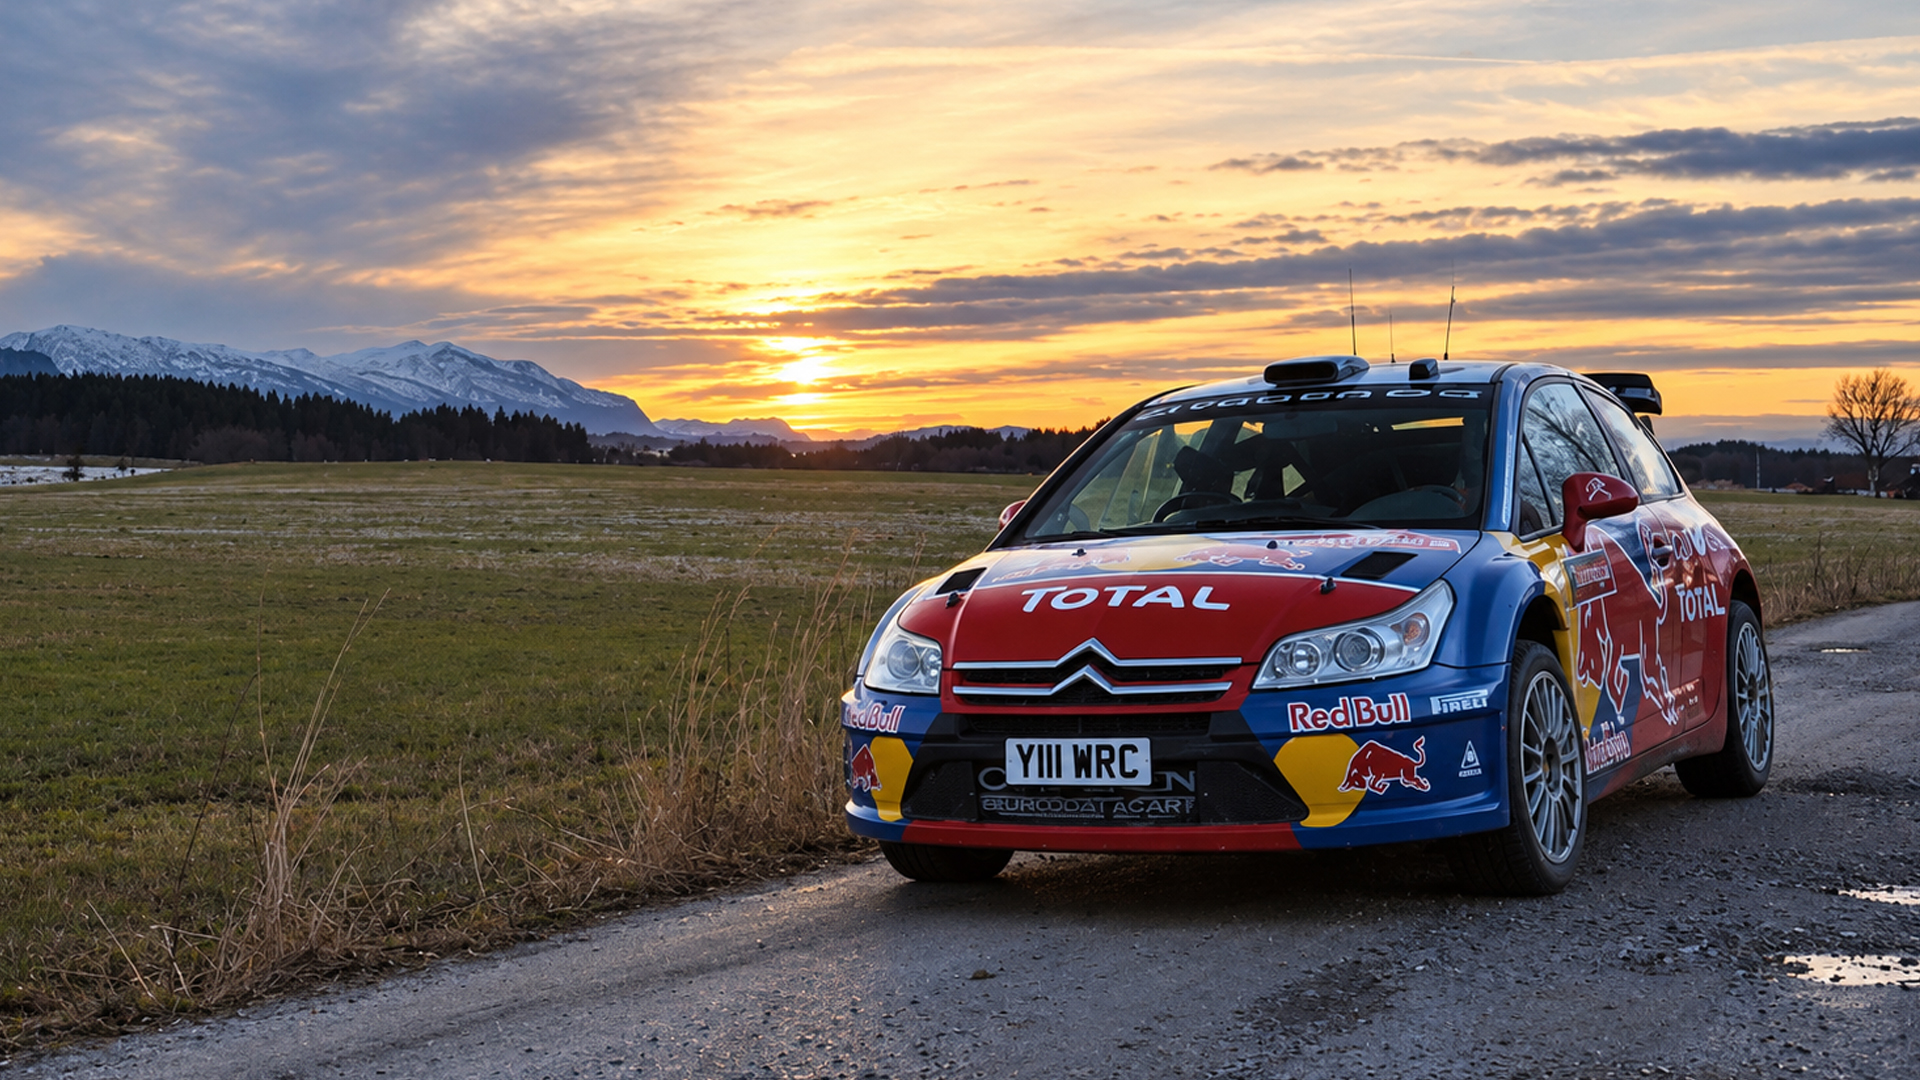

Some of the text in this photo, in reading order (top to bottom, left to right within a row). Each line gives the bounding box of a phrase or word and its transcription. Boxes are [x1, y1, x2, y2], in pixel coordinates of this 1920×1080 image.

[1021, 586, 1231, 613] TOTAL
[1675, 583, 1726, 622] TOTAL
[1288, 692, 1412, 733] Red Bull
[1072, 744, 1139, 779] WRC
